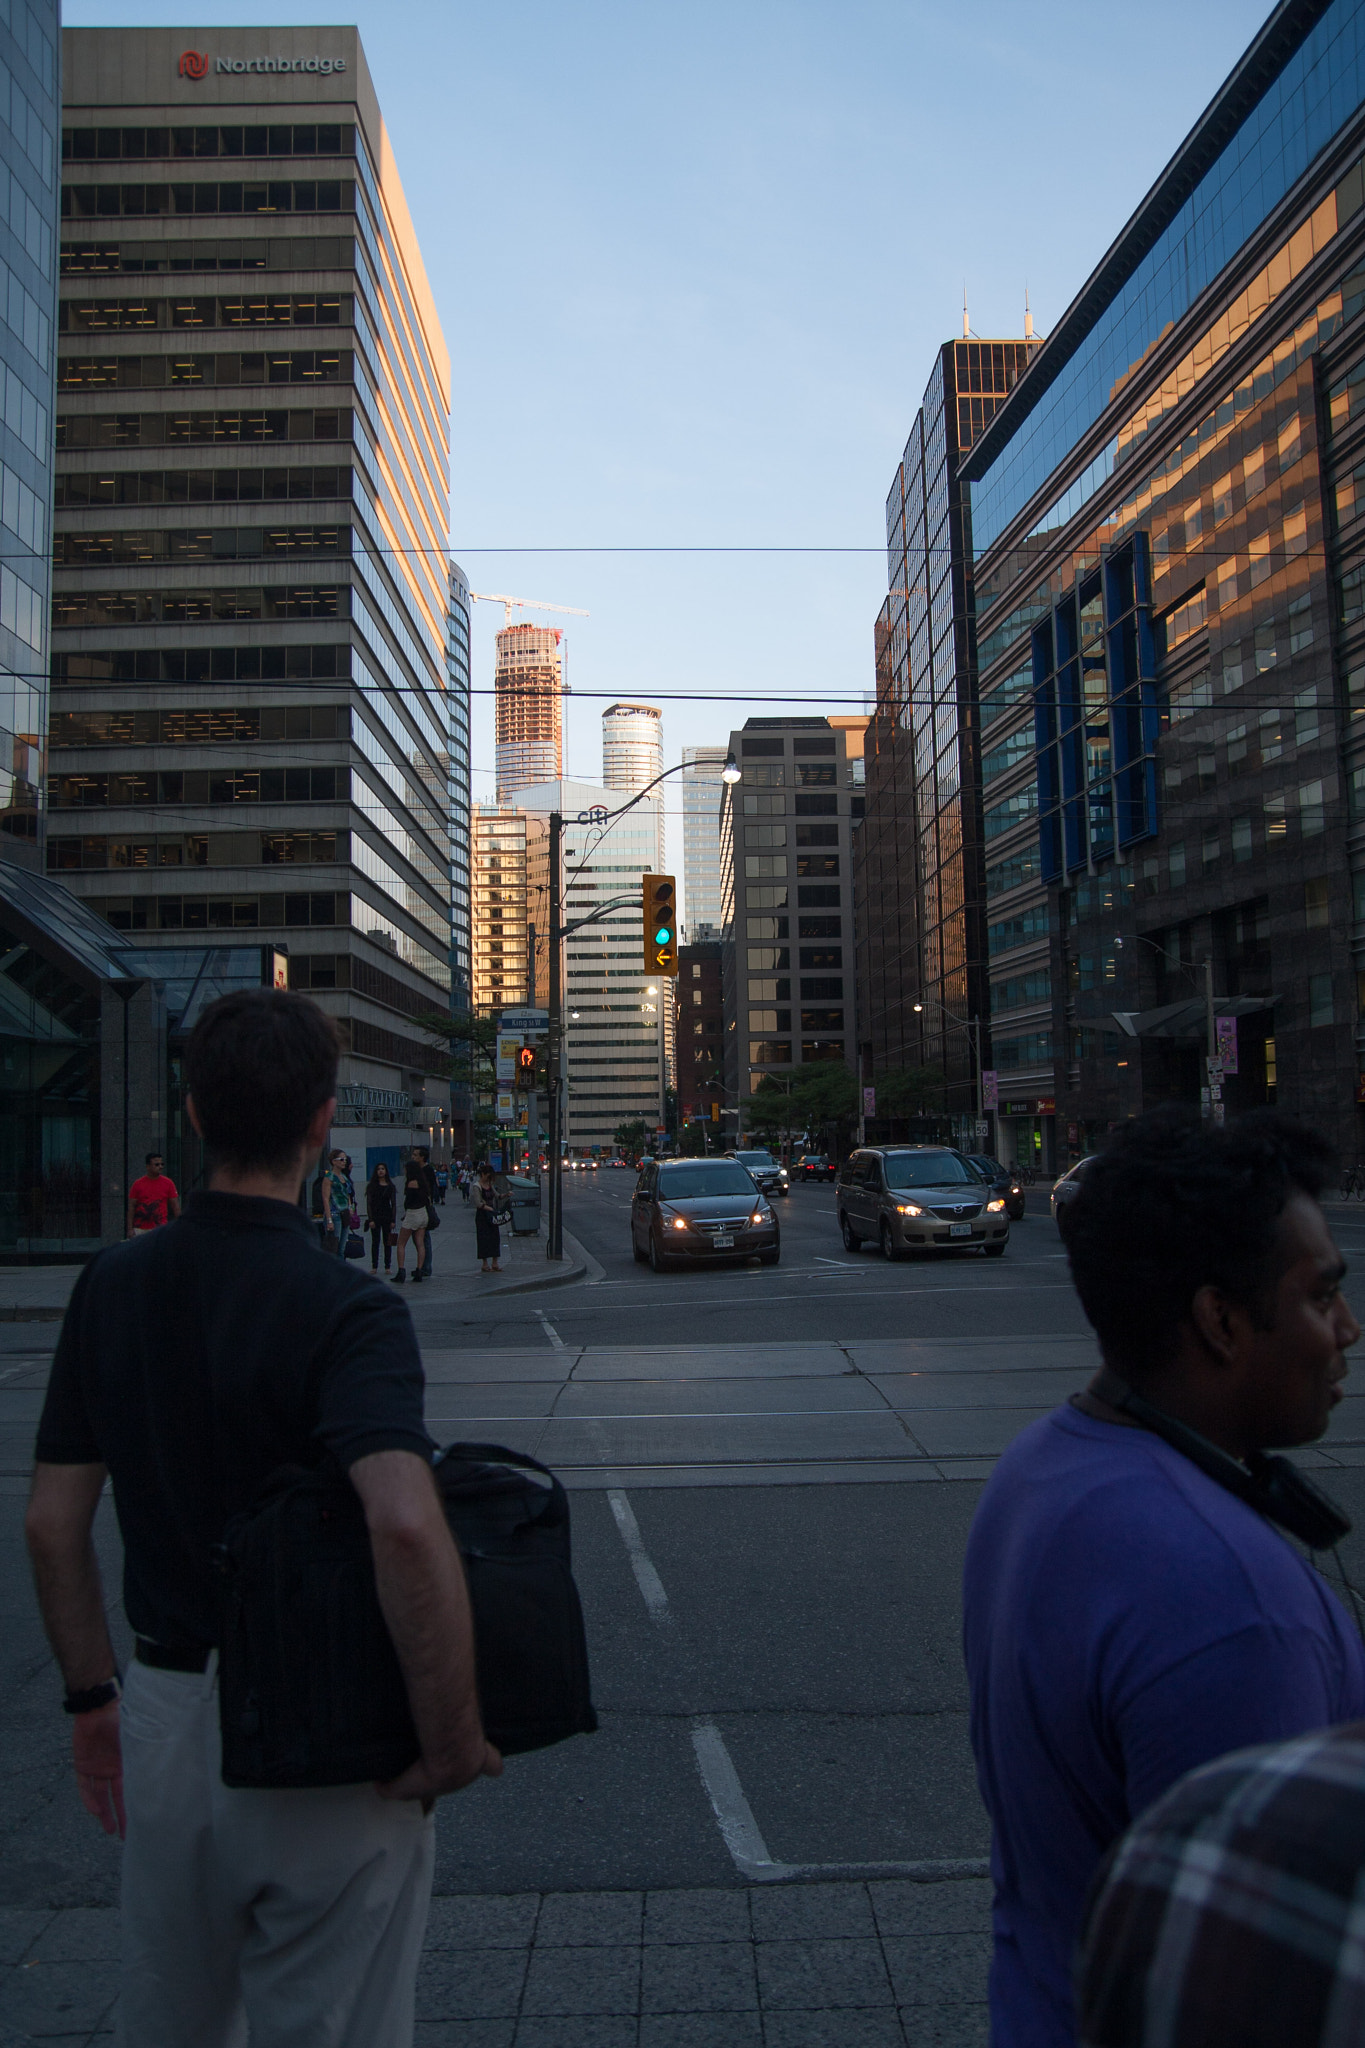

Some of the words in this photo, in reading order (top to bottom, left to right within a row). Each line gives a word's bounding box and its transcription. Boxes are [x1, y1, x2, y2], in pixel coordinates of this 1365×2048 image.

[216, 55, 347, 75] Northbridge
[577, 809, 608, 825] citi
[511, 1019, 528, 1027] King
[976, 1126, 987, 1135] 50
